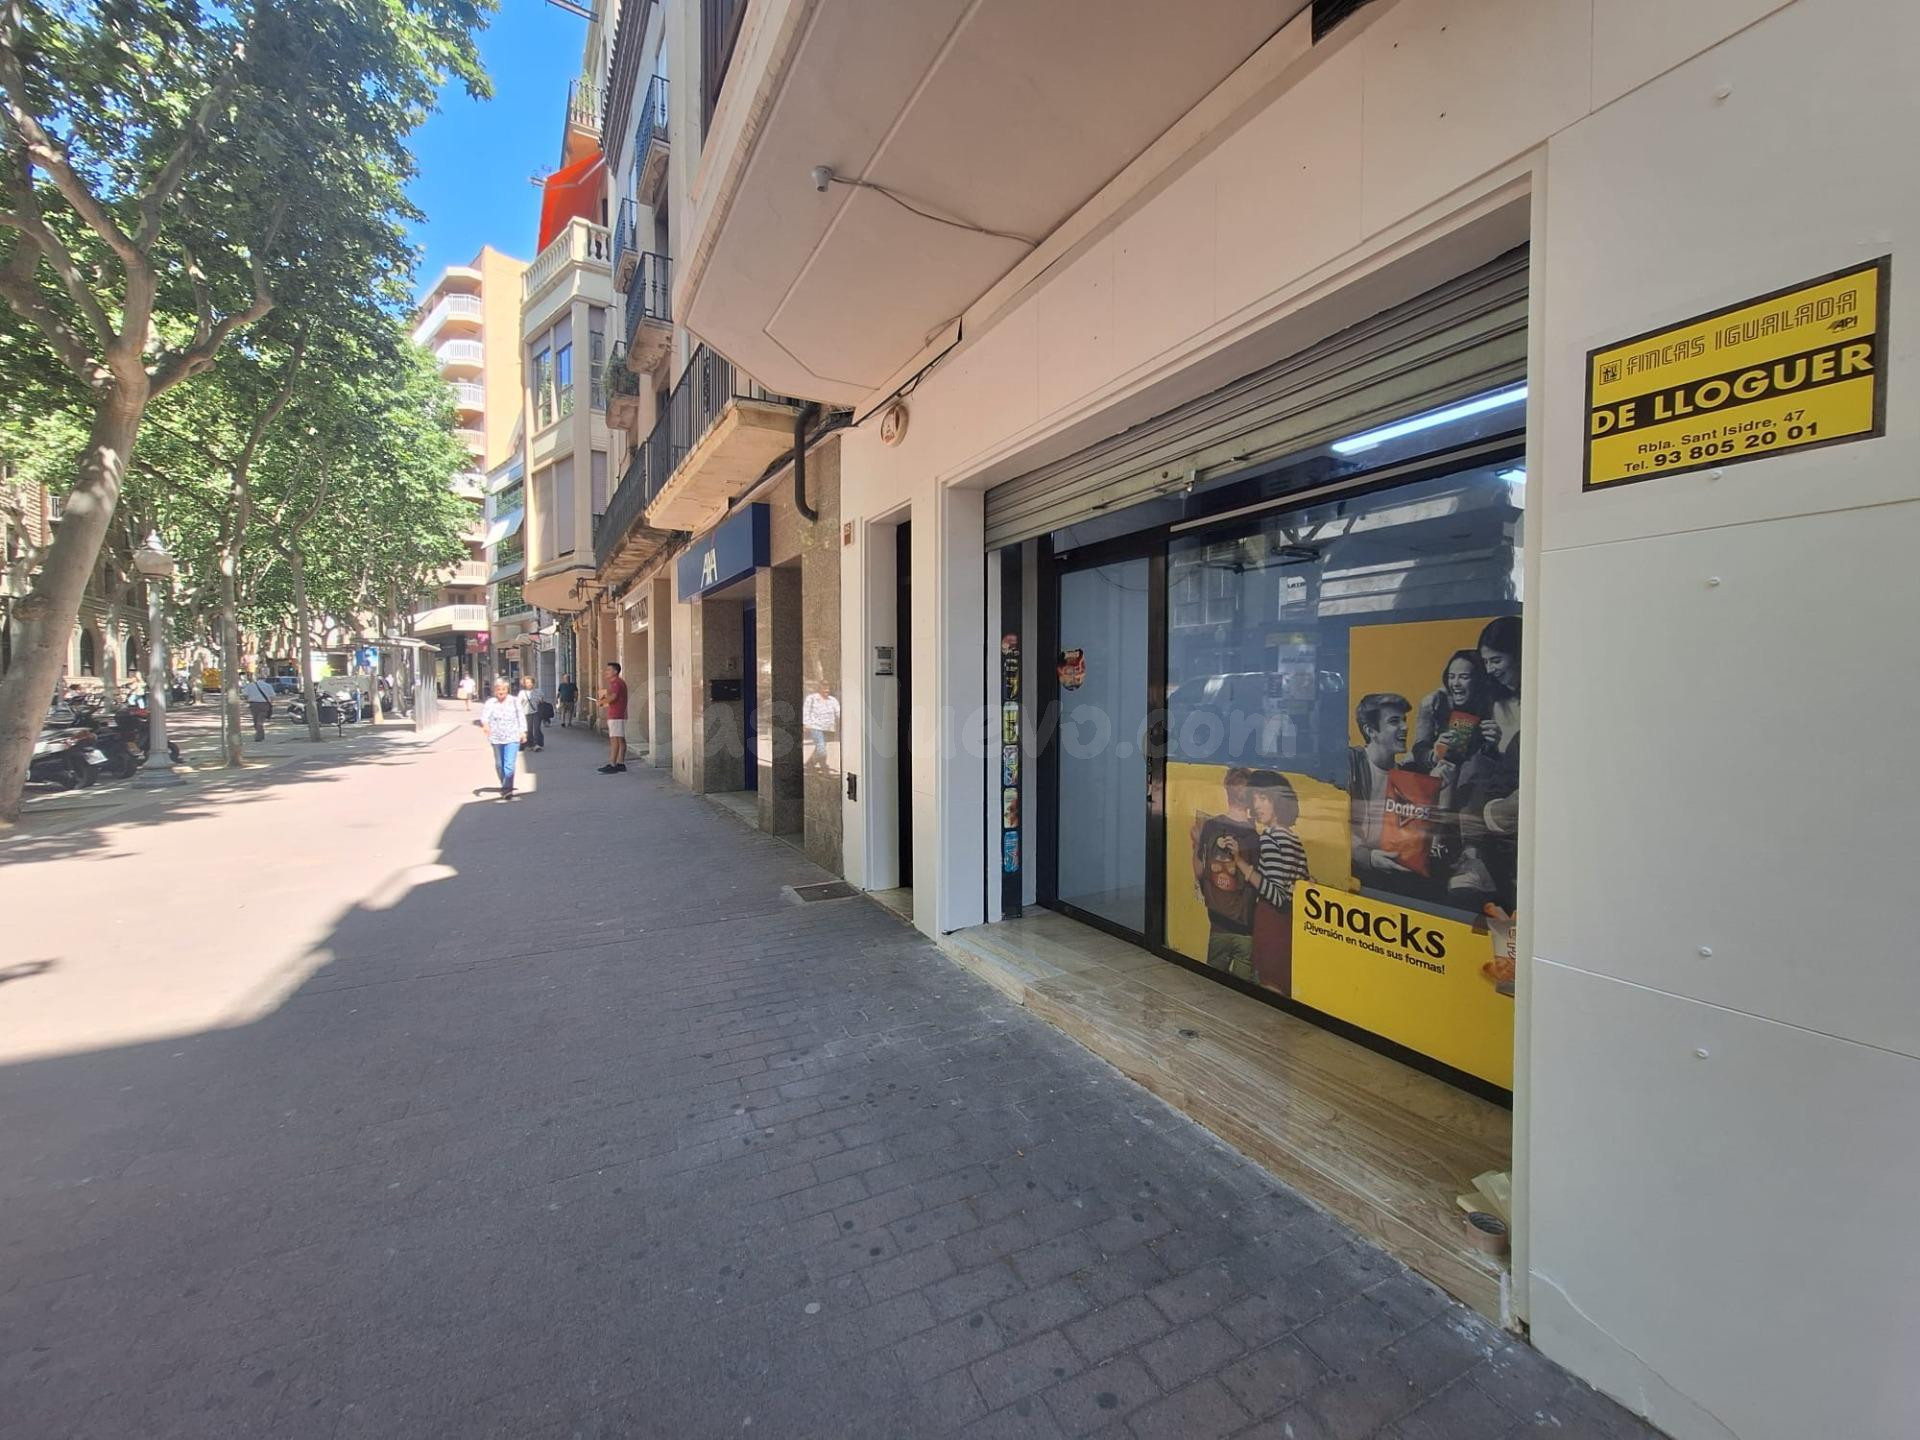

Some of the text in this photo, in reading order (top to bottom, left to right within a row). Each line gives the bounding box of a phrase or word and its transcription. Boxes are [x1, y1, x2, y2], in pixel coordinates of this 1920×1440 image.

[1626, 289, 1858, 376] FINCAS IGUALADA
[1591, 343, 1875, 436] DE LLOGUER
[1624, 422, 1819, 473] Tel. 93 805 20 01
[1638, 409, 1806, 455] Rbla. Sant Isidre, 47
[1304, 888, 1446, 959] Snacks
[1345, 935, 1357, 946] en
[1358, 939, 1385, 956] todas
[1386, 949, 1403, 961] sus
[1405, 953, 1446, 975] formas!
